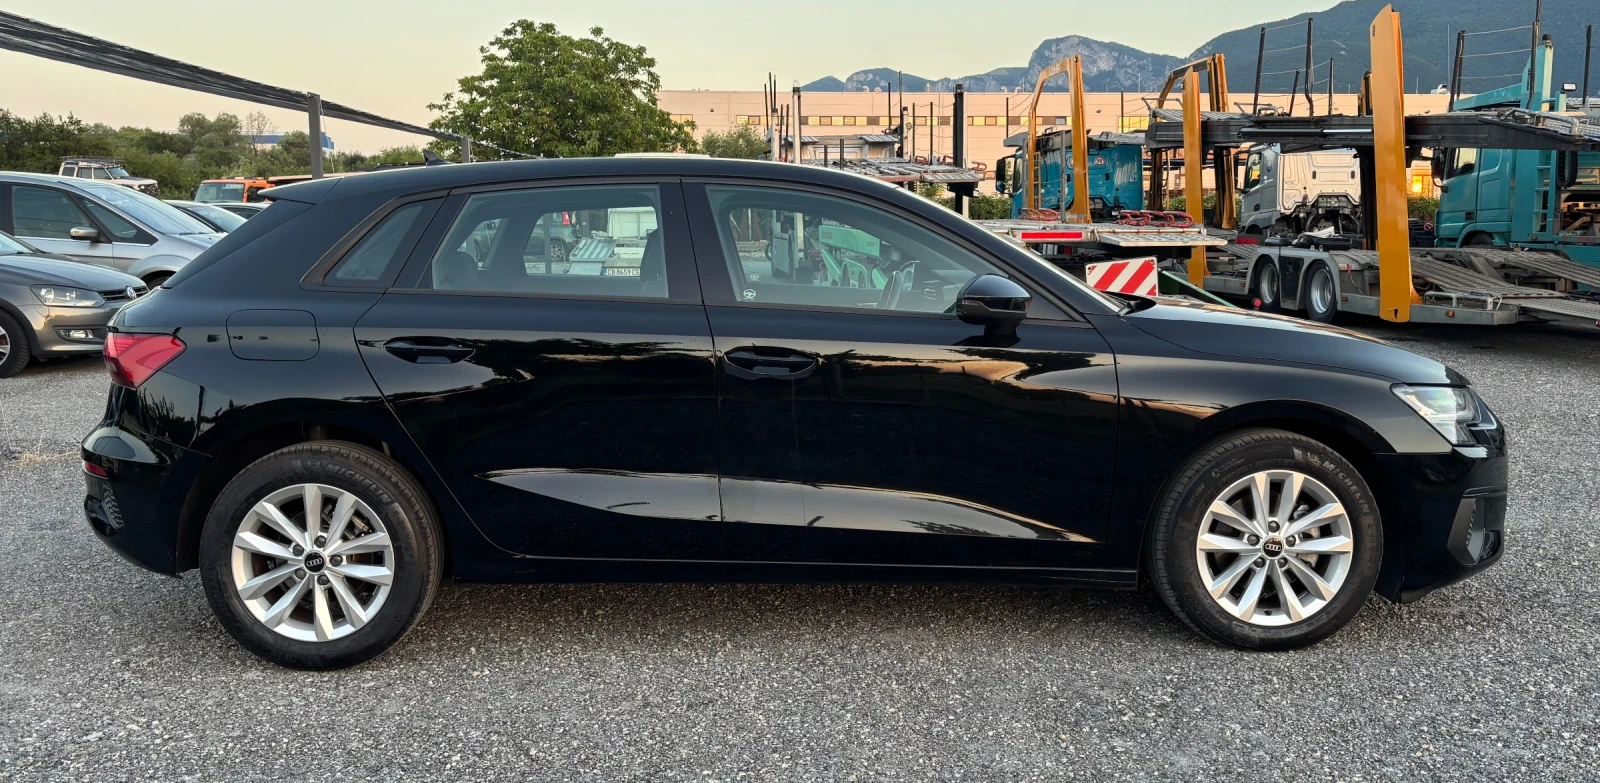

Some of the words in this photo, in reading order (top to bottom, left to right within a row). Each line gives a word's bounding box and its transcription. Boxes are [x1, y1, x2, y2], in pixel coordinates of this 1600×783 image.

[326, 465, 391, 503] MICHELIN
[1187, 482, 1206, 508] OUTSIDE
[1323, 461, 1370, 512] MICHELIN
